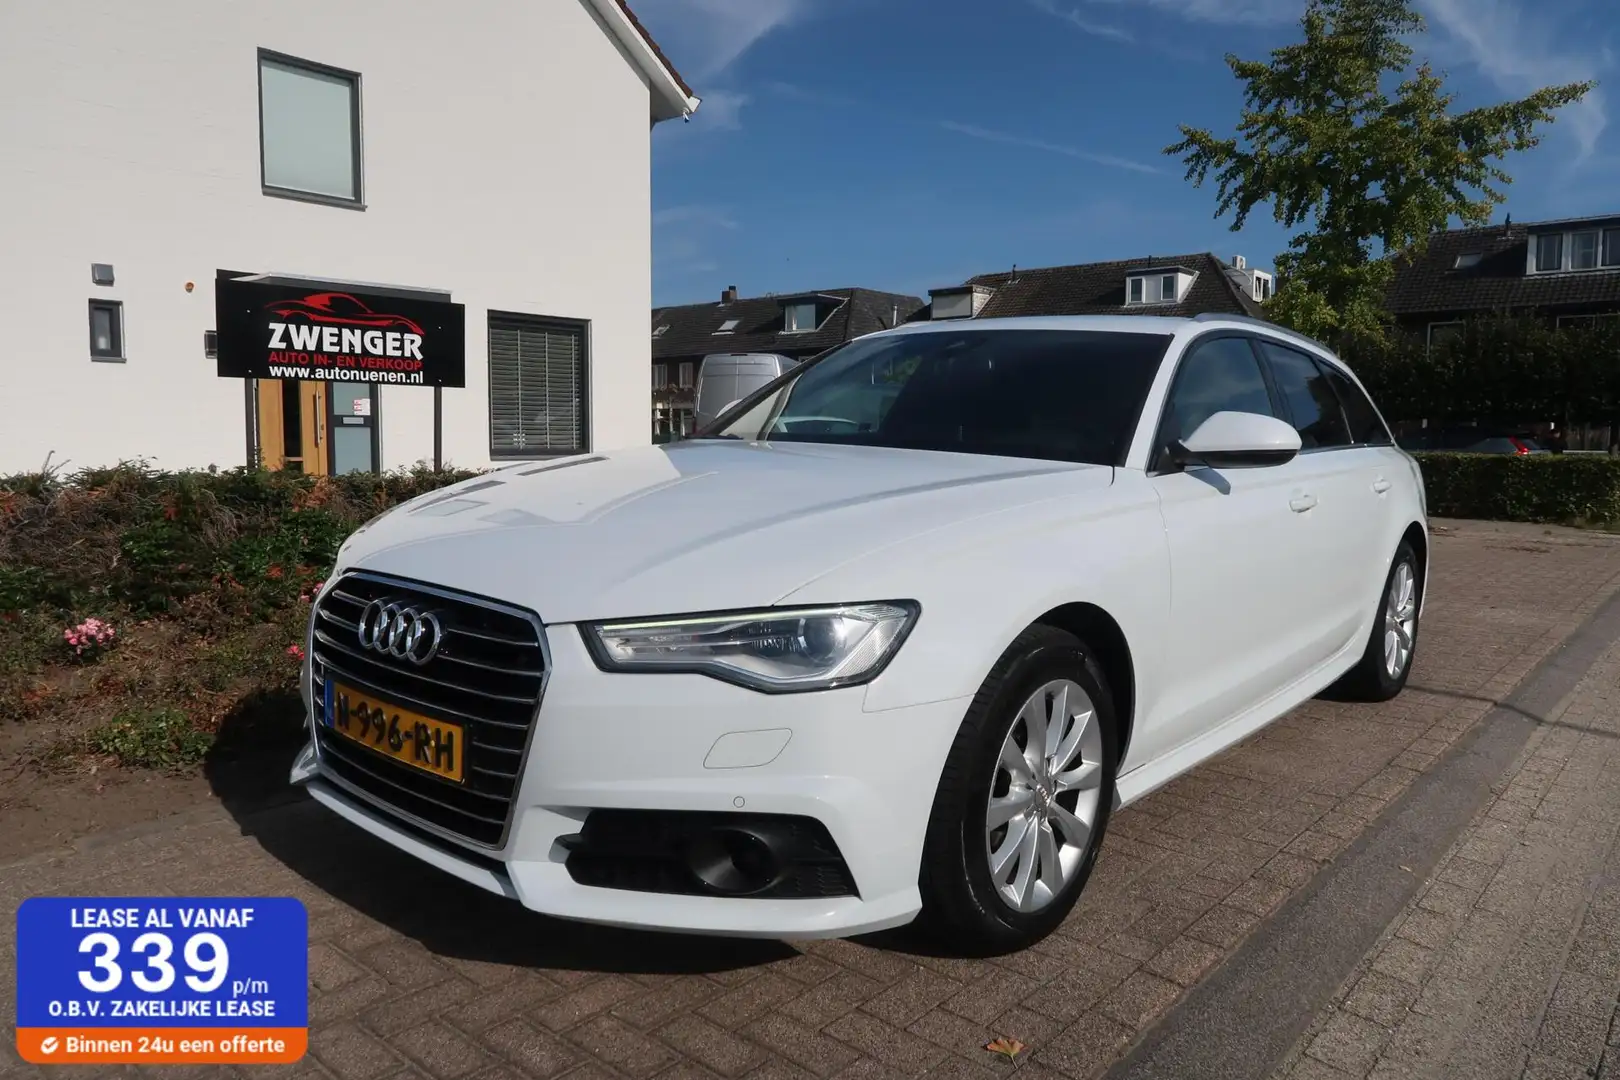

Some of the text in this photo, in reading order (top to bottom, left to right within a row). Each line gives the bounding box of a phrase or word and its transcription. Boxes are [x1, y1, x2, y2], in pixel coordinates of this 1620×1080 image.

[268, 322, 424, 360] ZWENGER
[269, 351, 423, 372] AUTO IN- EN VERKOOP
[269, 365, 424, 384] www.autonuenen.nl
